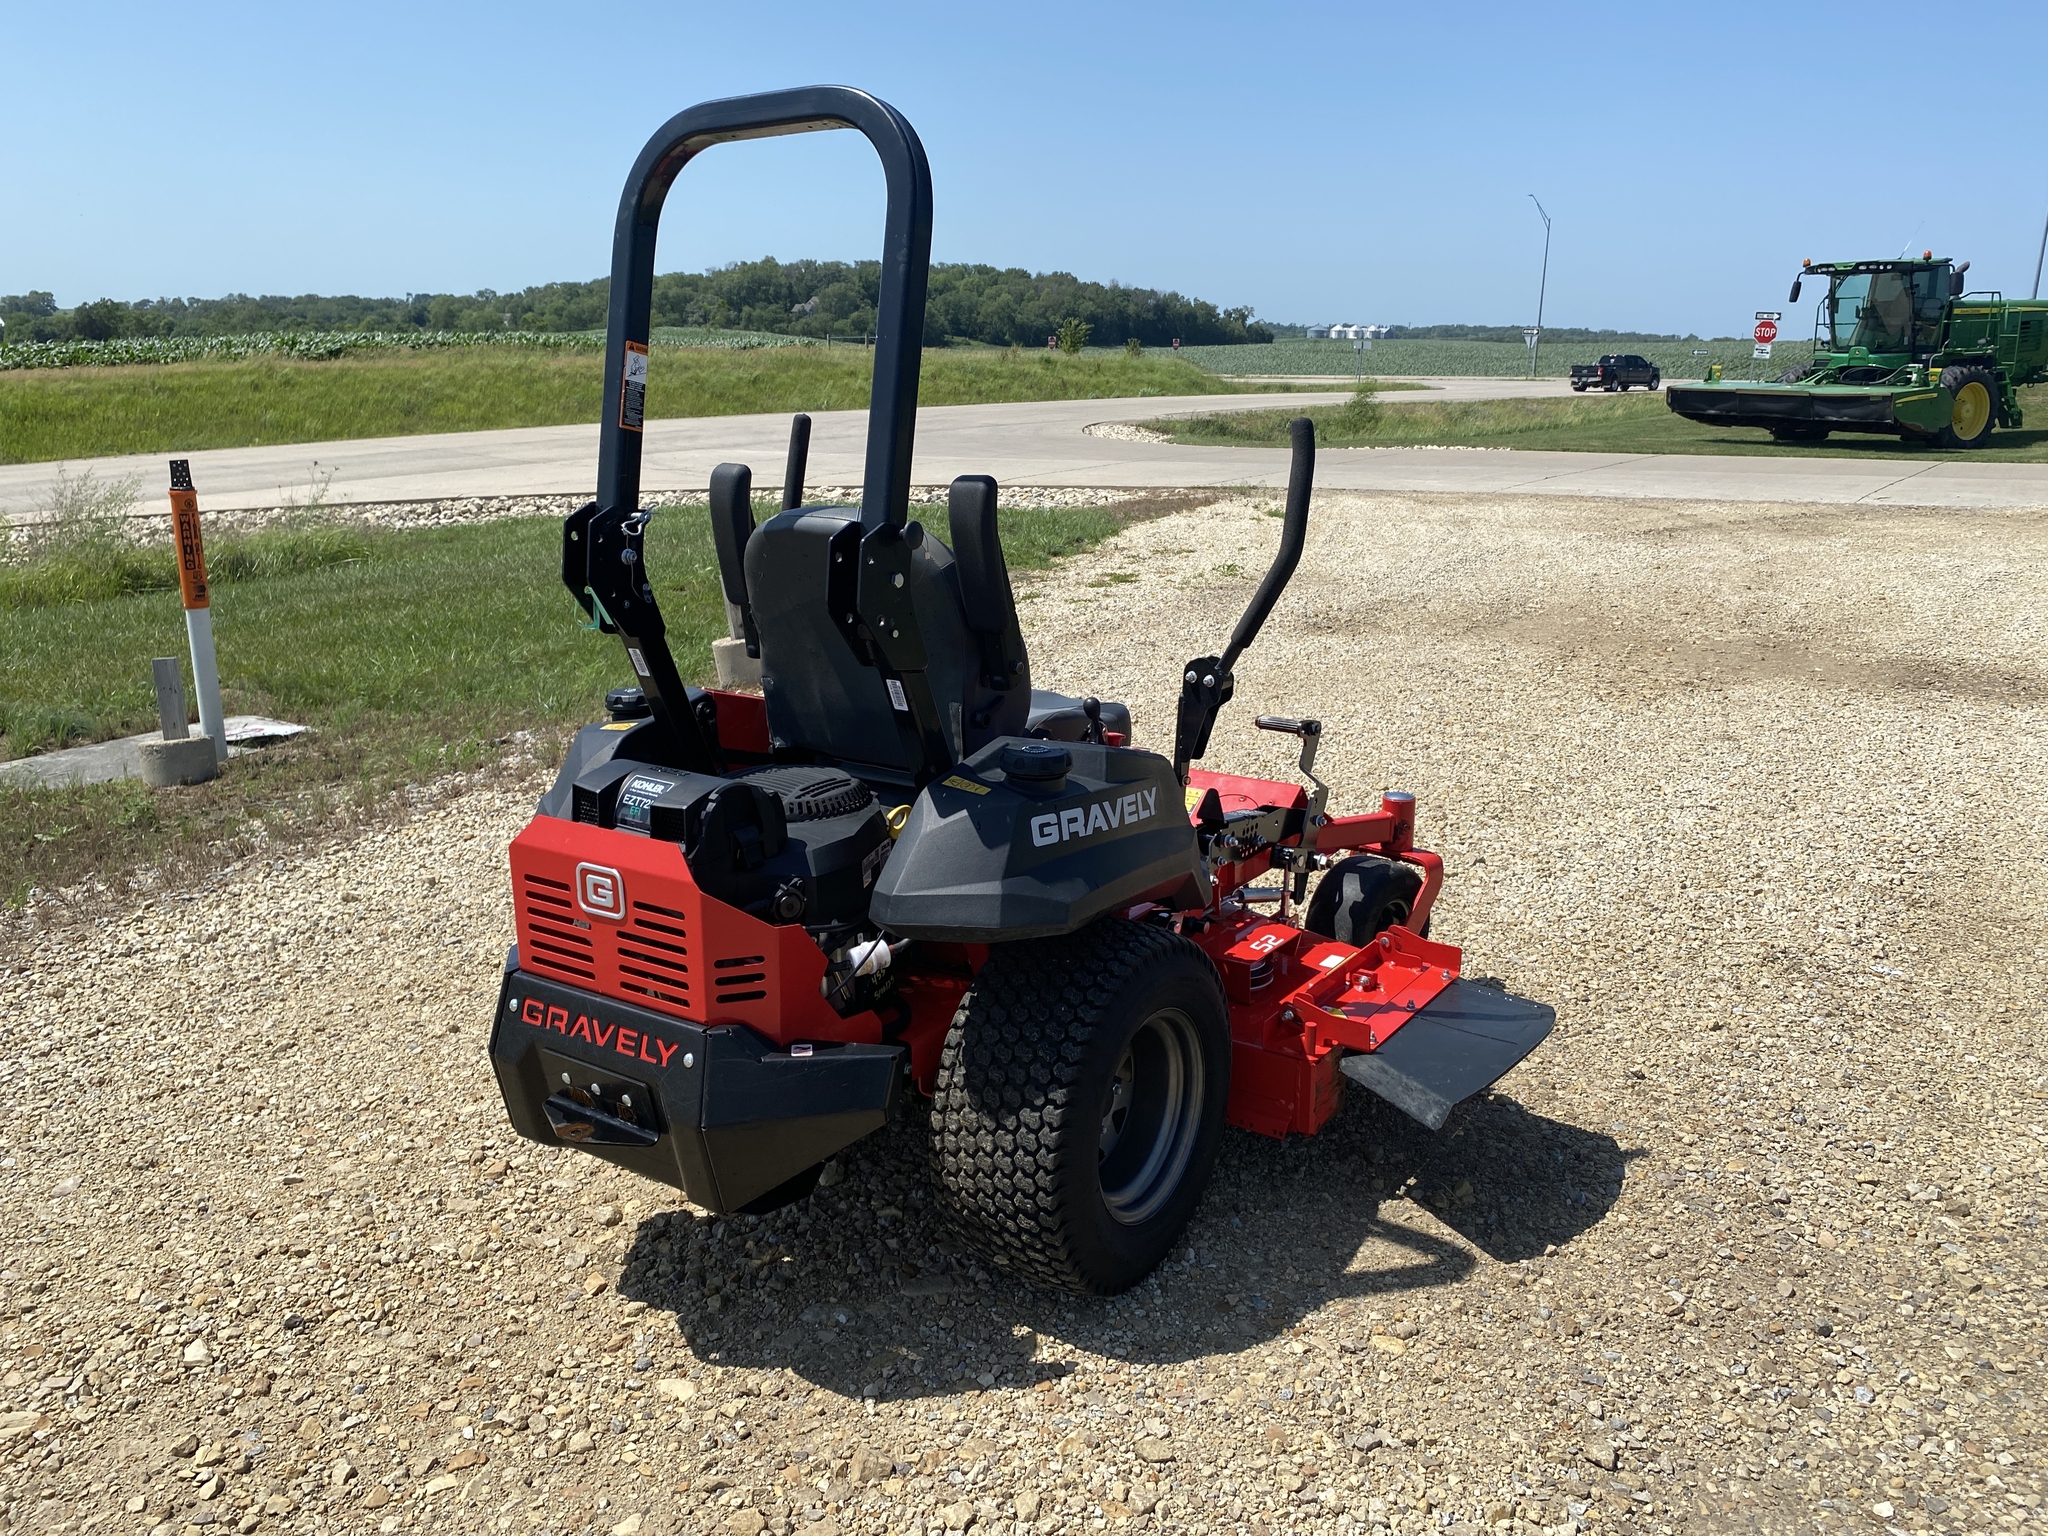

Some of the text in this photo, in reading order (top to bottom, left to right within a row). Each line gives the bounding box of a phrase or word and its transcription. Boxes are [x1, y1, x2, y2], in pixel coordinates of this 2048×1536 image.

[1755, 327, 1776, 338] STOP
[180, 514, 195, 570] WARNING
[631, 780, 664, 794] KOHLER
[630, 806, 641, 816] EFI
[1030, 787, 1157, 848] GRAVELY
[1249, 934, 1285, 953] 52
[521, 997, 679, 1068] GRAVELY
